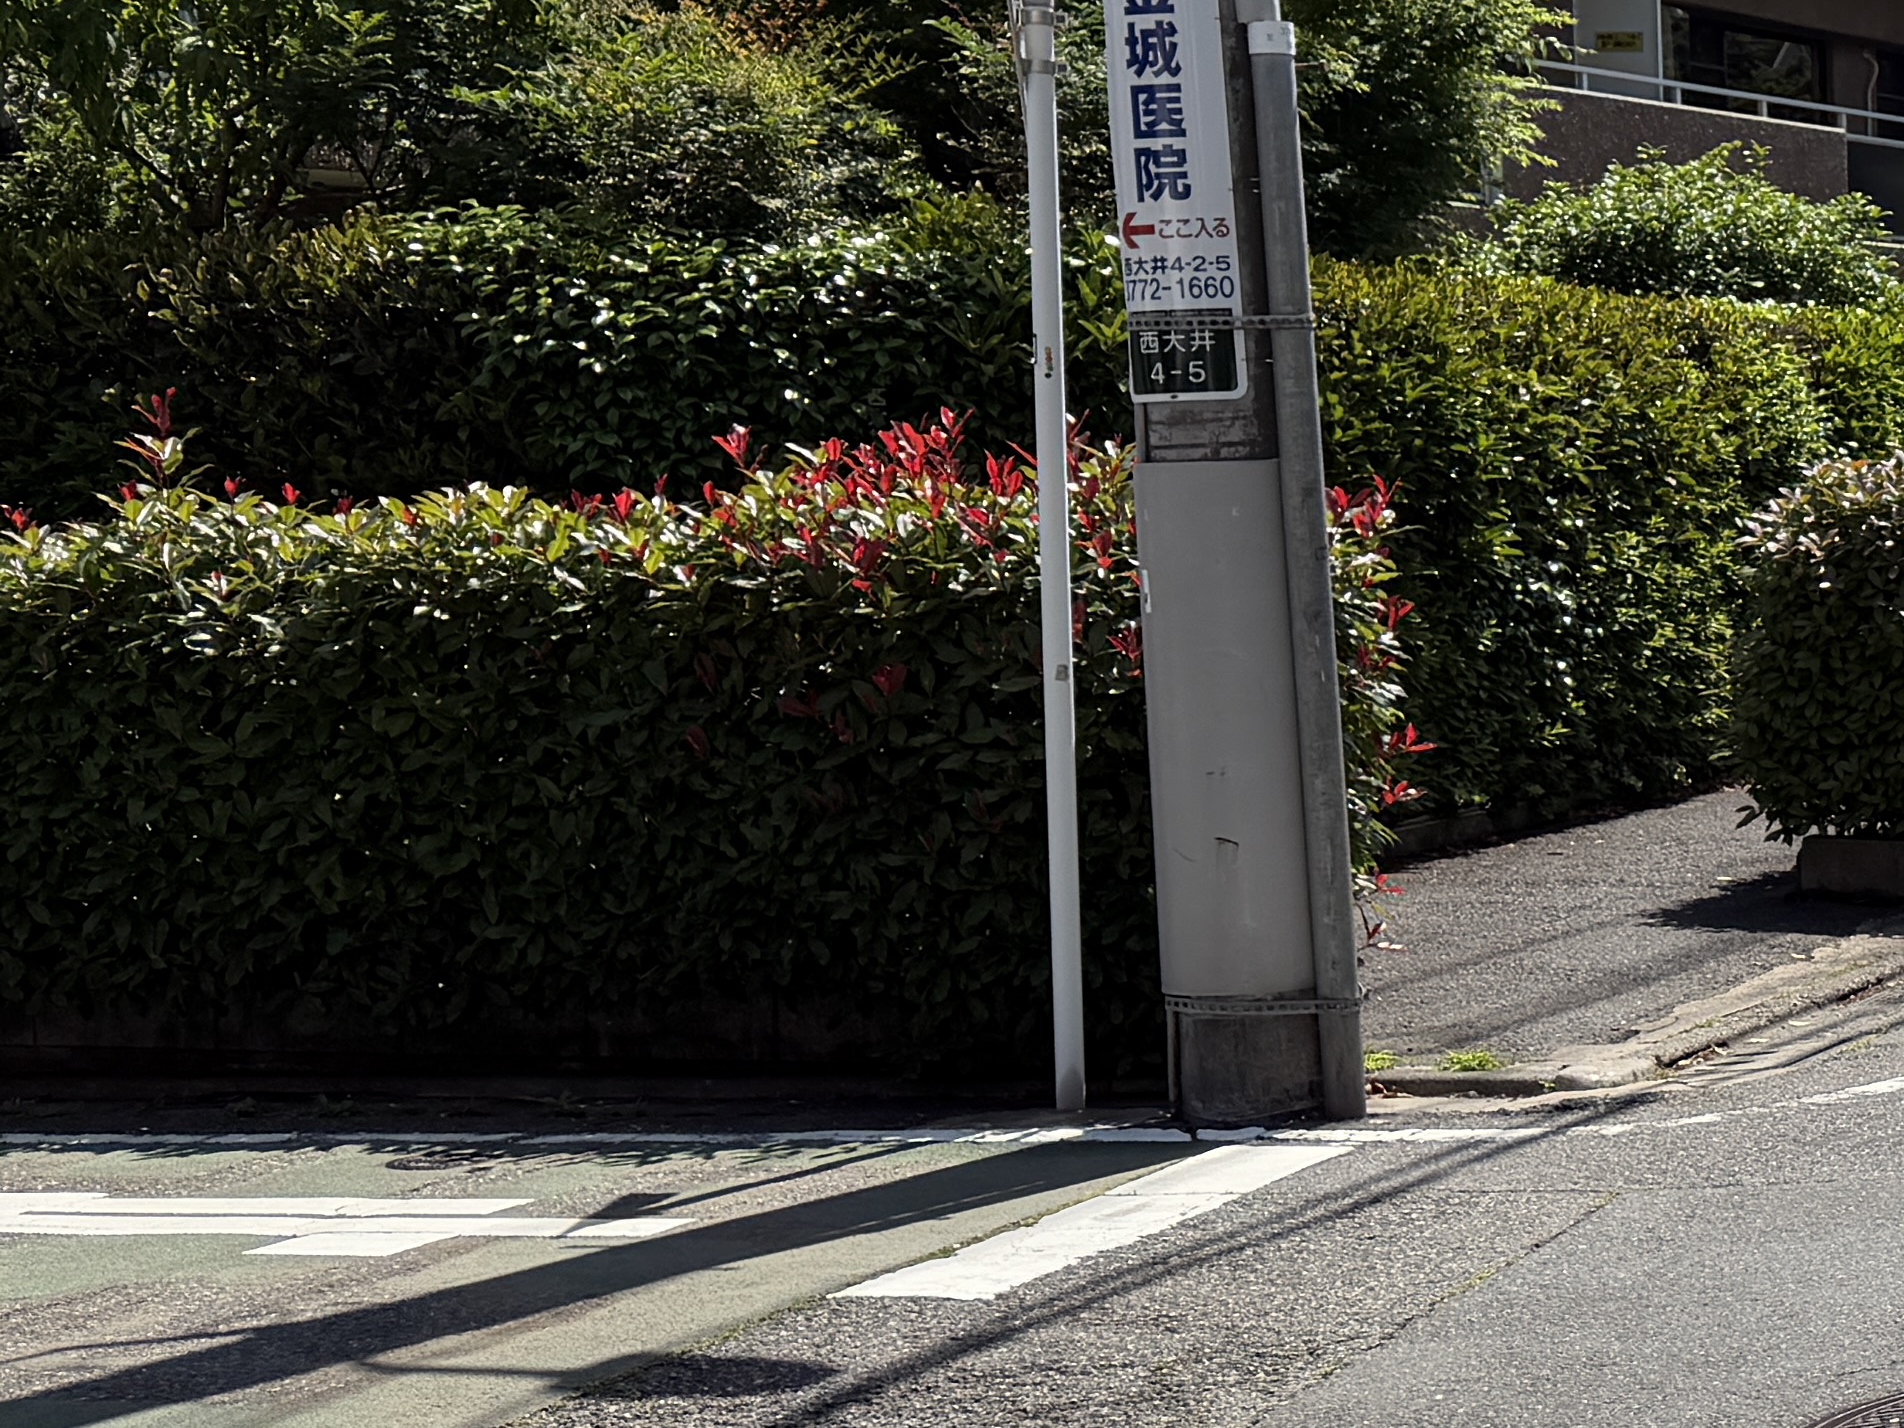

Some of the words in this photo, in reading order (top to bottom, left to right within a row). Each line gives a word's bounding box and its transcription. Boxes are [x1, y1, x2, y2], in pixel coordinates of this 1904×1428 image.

[1158, 217, 1230, 239] ここ入る
[1139, 329, 1216, 354] 西大井
[1150, 361, 1207, 385] 4-5
